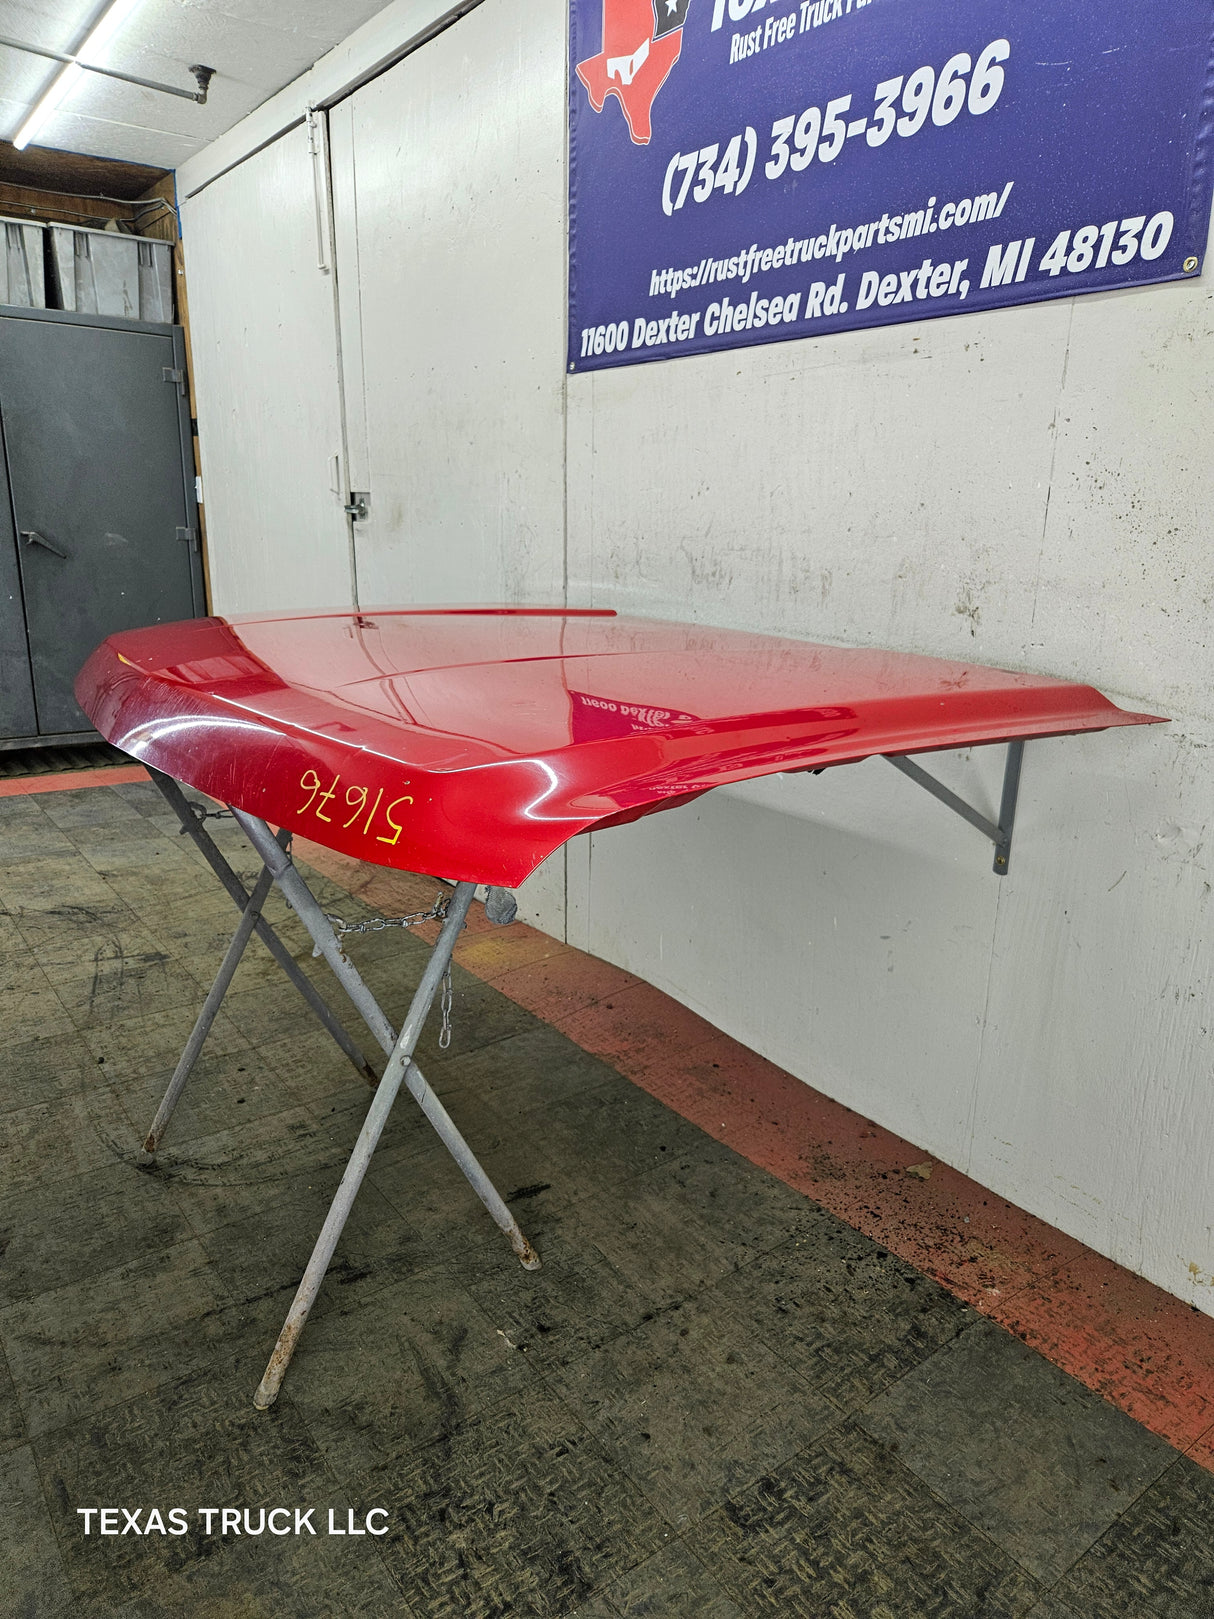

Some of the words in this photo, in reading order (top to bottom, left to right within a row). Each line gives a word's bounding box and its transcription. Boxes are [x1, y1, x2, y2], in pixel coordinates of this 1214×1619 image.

[729, 24, 762, 65] Rust
[762, 12, 797, 50] Free
[661, 126, 758, 217] (734)
[764, 38, 1011, 180] 395-3966
[580, 320, 629, 357] 11600
[631, 310, 701, 349] Dexter
[703, 291, 802, 336] Chelsea
[804, 273, 849, 319] Rd.
[855, 258, 970, 311] Dexter,
[979, 237, 1036, 289] MI
[1038, 210, 1174, 277] 48130
[649, 182, 1015, 299] https://rustfreetruckpartsmi.com/
